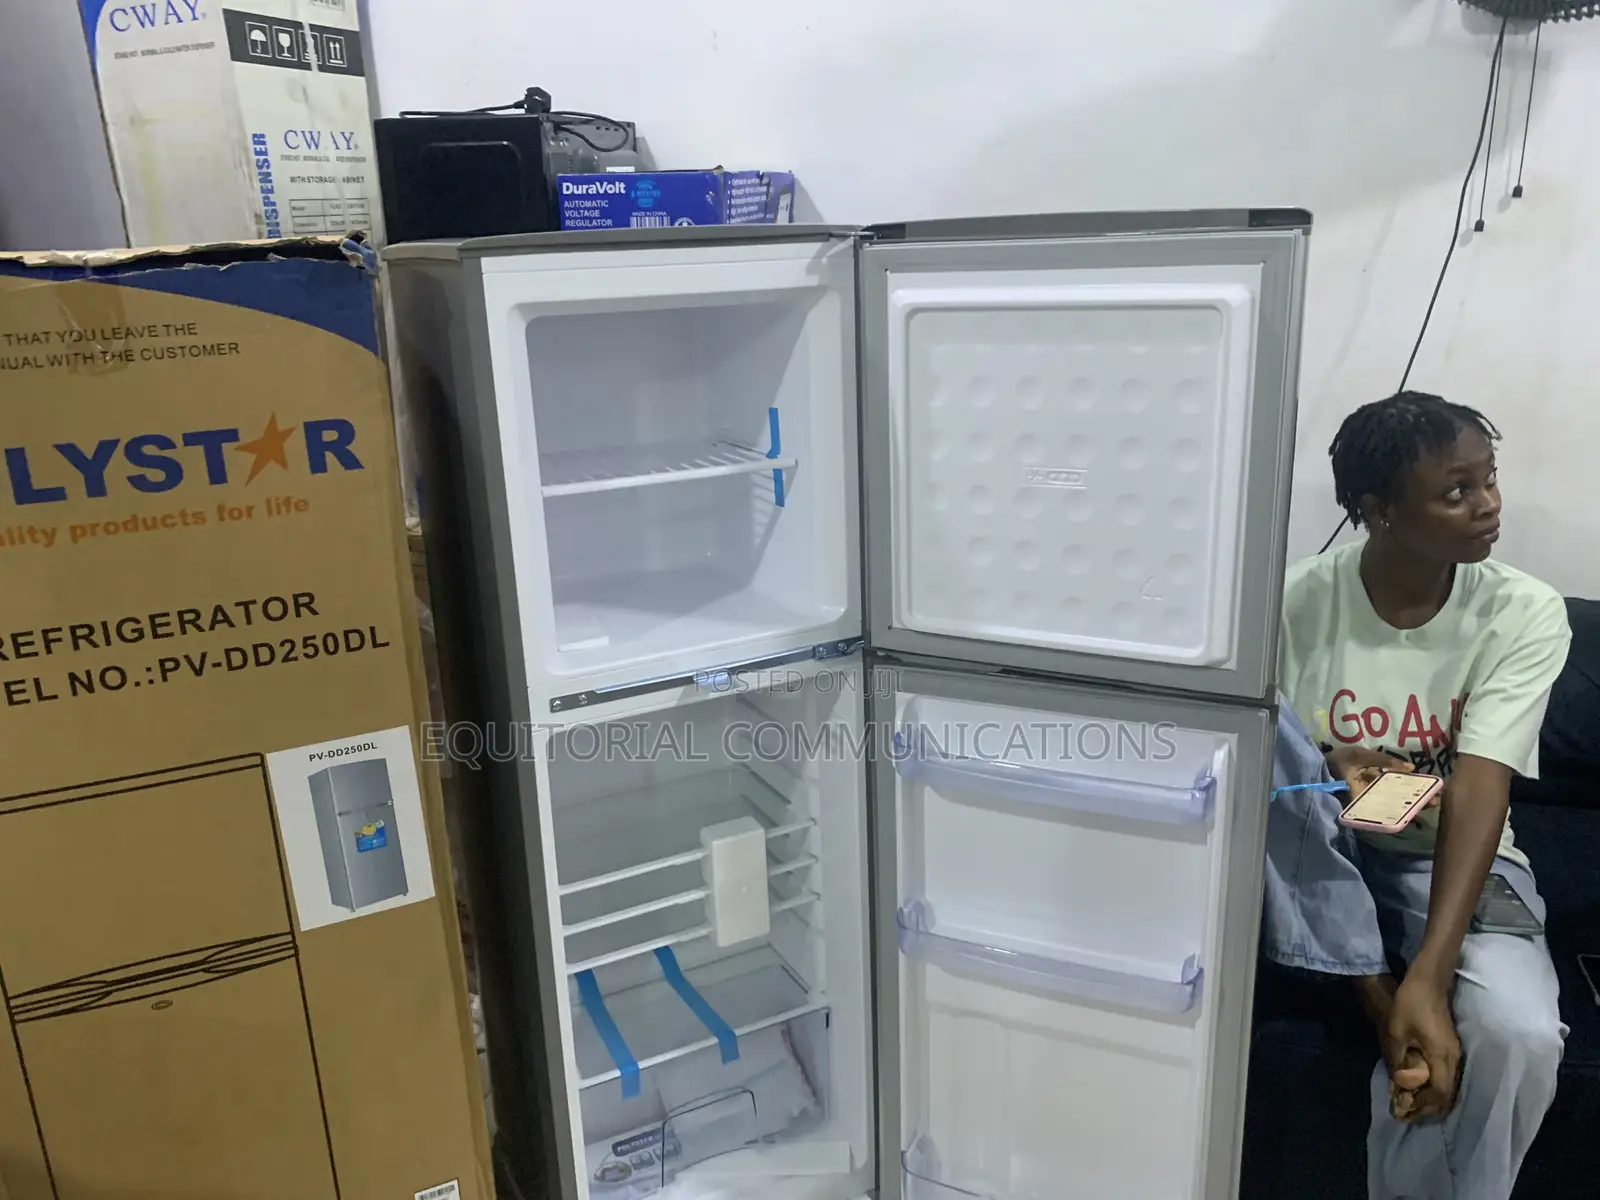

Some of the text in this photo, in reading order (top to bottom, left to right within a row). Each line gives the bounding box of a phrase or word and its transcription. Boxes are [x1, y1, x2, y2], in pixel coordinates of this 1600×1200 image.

[109, 0, 199, 32] CWAY
[562, 181, 626, 195] DuraVolt
[564, 200, 609, 208] AUTOMATIC
[565, 219, 613, 227] REGULATOR
[4, 323, 198, 346] THAT YOU LEAVE THE
[47, 351, 95, 367] WITH
[100, 349, 135, 363] THE
[140, 342, 241, 361] CUSTOMER
[70, 508, 207, 545] products
[216, 503, 255, 523] for
[265, 496, 310, 516] life
[308, 742, 378, 762] PV-DD250DL
